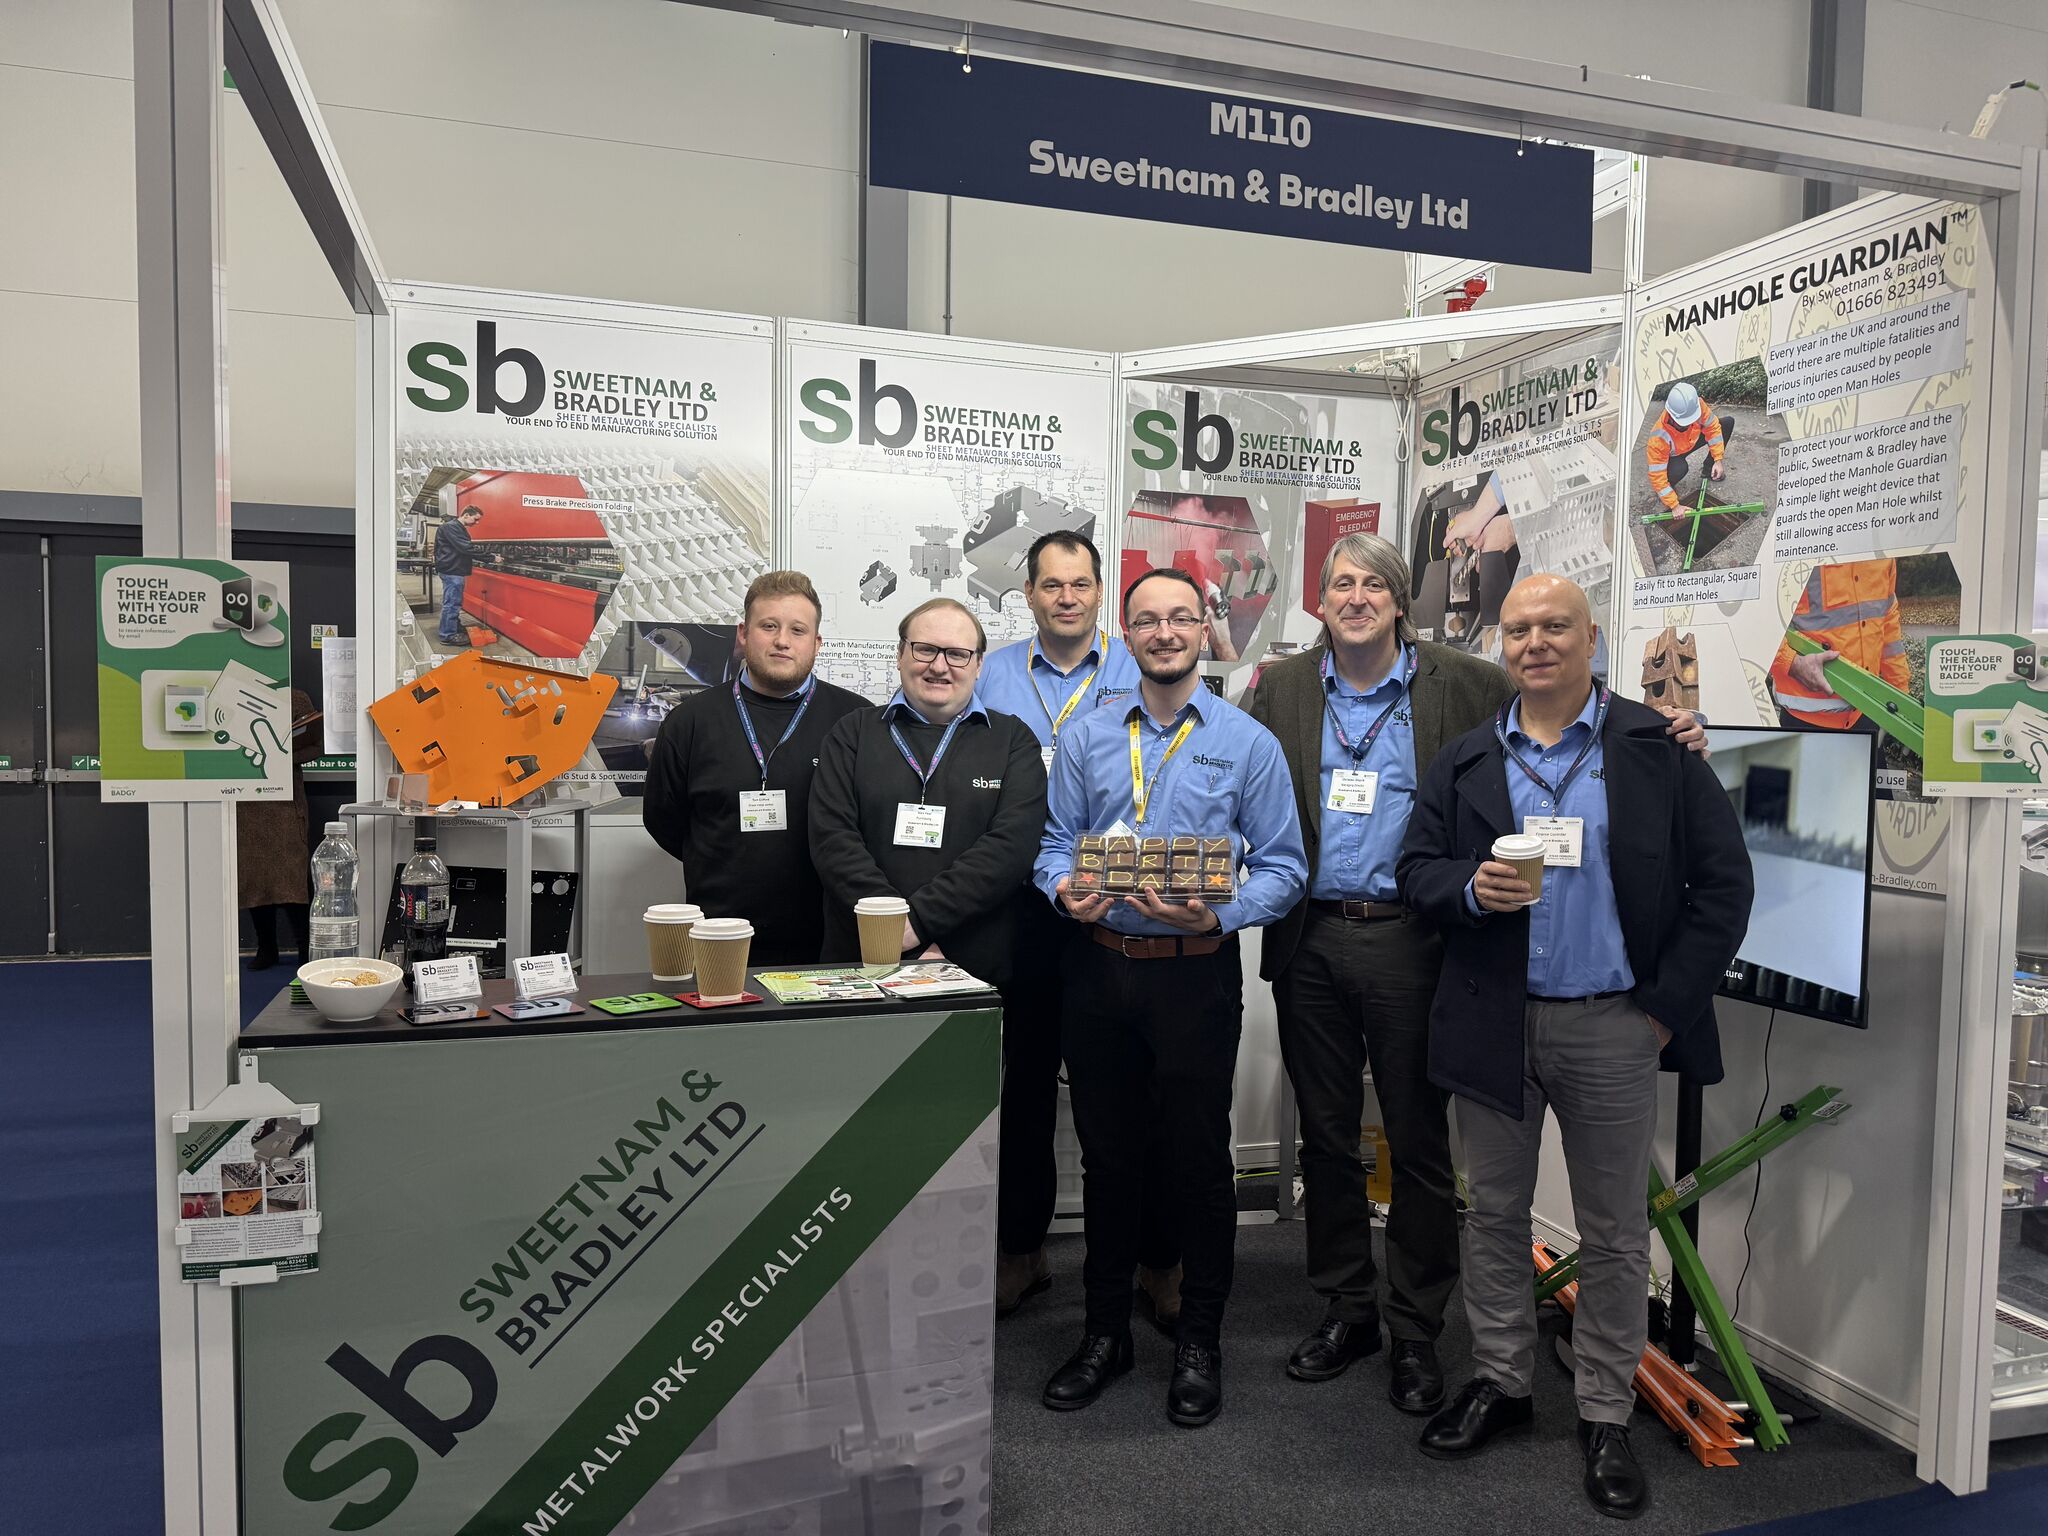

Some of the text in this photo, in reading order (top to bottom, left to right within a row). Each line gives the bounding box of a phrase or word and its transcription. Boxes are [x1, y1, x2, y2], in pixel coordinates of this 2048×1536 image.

[1210, 102, 1311, 148] M110
[1028, 139, 1469, 230] Sweetnam & Bradley Ltd
[1801, 253, 1945, 307] By Sweetnam & Bradley
[1837, 270, 1946, 315] 01666 823491
[1665, 273, 1784, 336] MANHOLE
[1769, 315, 1959, 377] world there are multiple fatalities and
[1770, 302, 1950, 360] Every year in the UK and around the
[406, 320, 546, 418] sb
[553, 370, 715, 401] SWEETNAM &
[1482, 357, 1599, 415] SWEETNAM &
[1768, 344, 1931, 394] serious injuries caused by people
[554, 392, 707, 421] BRADLEY LTD
[799, 358, 918, 449] sb
[1768, 371, 1900, 410] falling into open Man Holes
[505, 417, 717, 440] YOUR END TO END MANUFACTURING SOLUTION
[556, 413, 716, 432] SHEET METALWORK SPECIALISTS
[924, 406, 1061, 432] SWEETNAM &
[1131, 391, 1235, 474] sb
[1421, 386, 1482, 467] sb
[1481, 390, 1597, 441] BRADLEY LTD
[925, 426, 1053, 451] BRADLEY LTD
[1240, 433, 1361, 457] SWEETNAM &
[1779, 413, 1952, 457] To protect your workforce and the
[1239, 452, 1354, 474] BRADLEY LTD
[1778, 453, 1947, 490] developed the Manhole Guardian
[1779, 434, 1946, 476] public, Sweetnam & Bradley have
[523, 497, 632, 512] Press Brake Precision Folding
[1777, 472, 1940, 507] A simple light weight device that
[1336, 509, 1376, 522] EMERGENCY
[1776, 490, 1942, 526] guards the open Man Hole whilst
[1776, 508, 1938, 541] still allowing access for work and
[1339, 520, 1372, 534] BLEED KIT
[1775, 543, 1838, 557] maintenance.
[116, 577, 167, 588] TOUCH
[117, 590, 206, 601] THE READER
[1634, 590, 1718, 605] and Round Man Holes
[1635, 572, 1757, 591] Easily fit to Rectangular, Square
[118, 602, 198, 613] WITH YOUR
[118, 614, 166, 624] BADGE
[847, 641, 895, 651] Manufacturing
[111, 789, 136, 797] BADGY
[571, 772, 588, 781] Stud
[590, 773, 598, 781] &
[599, 773, 615, 783] Spot
[1886, 776, 1905, 786] use
[460, 1068, 723, 1324] SWEETNAM &
[494, 1100, 748, 1357] BRADLEY LTD
[521, 1185, 854, 1536] METALWORK SPECIALISTS
